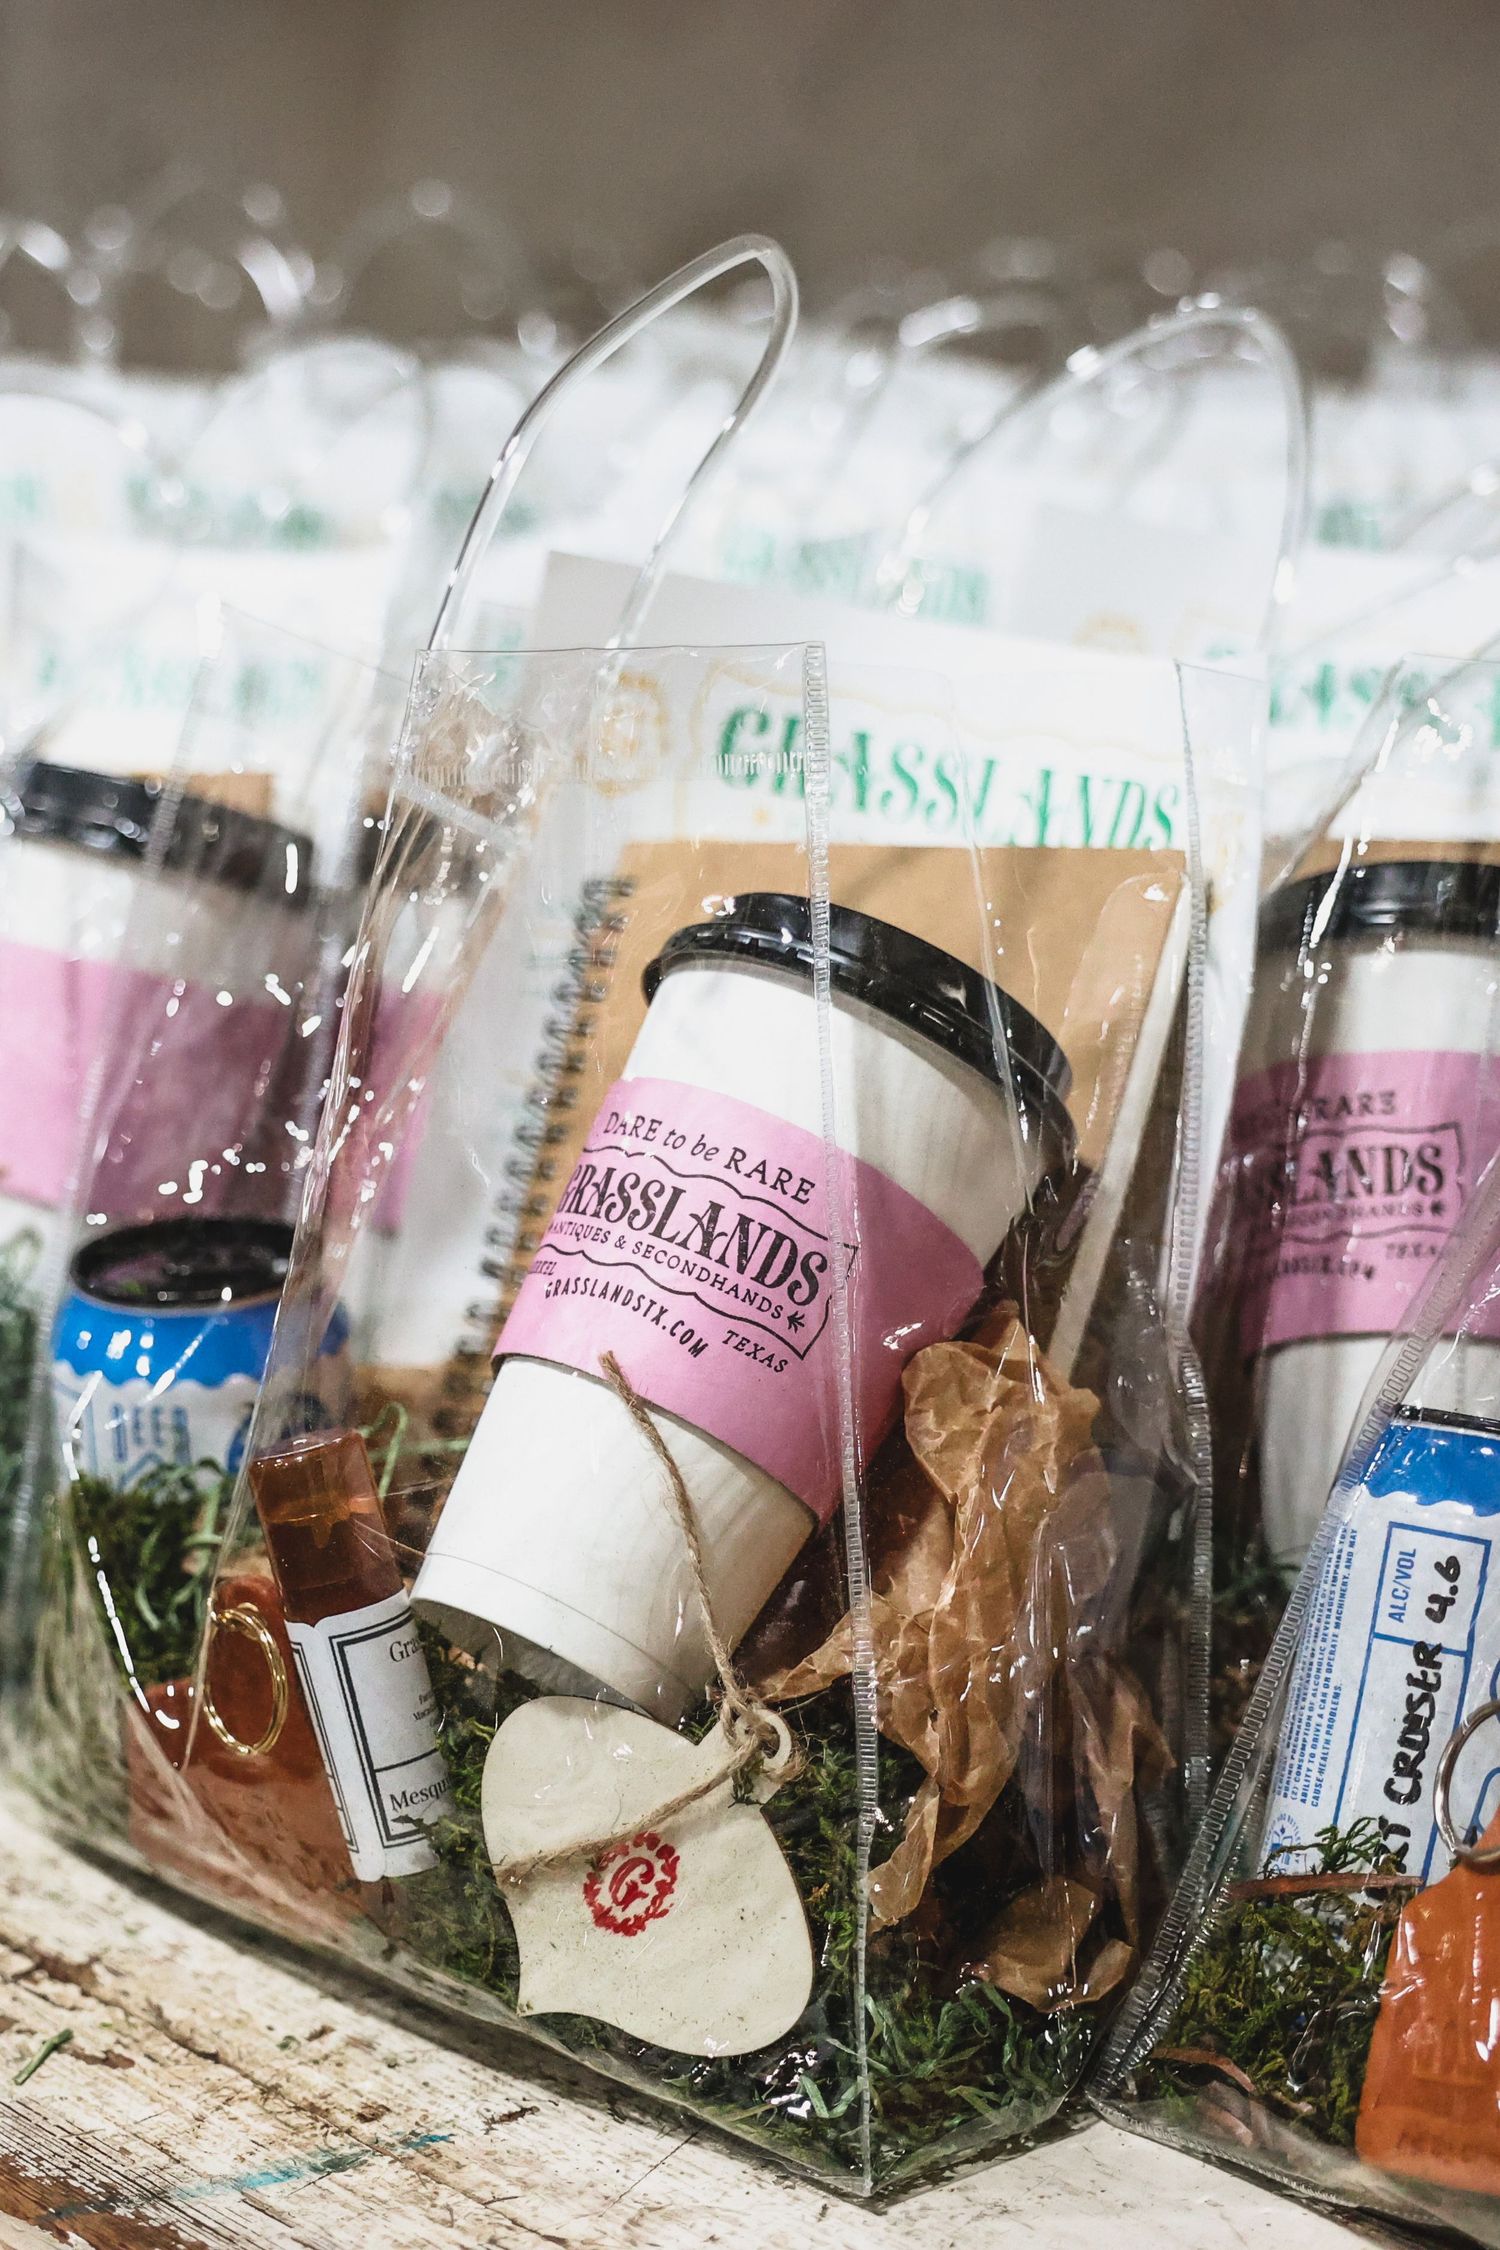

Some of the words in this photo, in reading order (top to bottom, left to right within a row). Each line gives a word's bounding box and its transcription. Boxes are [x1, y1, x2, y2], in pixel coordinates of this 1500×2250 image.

[604, 1112, 662, 1142] DARE
[663, 1129, 686, 1149] to
[691, 1134, 720, 1161] be
[723, 1147, 815, 1205] RARE
[556, 1164, 828, 1306] GRASSLANDS
[550, 1221, 611, 1244] ANTIQUES
[614, 1235, 627, 1249] &
[632, 1241, 784, 1319] SECONDHANDS
[545, 1277, 709, 1358] GRASSLANDSTX.COM
[722, 1329, 788, 1373] TEXAS
[1348, 1528, 1358, 1548] MAY
[1344, 1550, 1353, 1570] AND
[1388, 1548, 1416, 1623] ALC/VOL
[1425, 1555, 1460, 1624] 4.6
[389, 1638, 421, 1662] Gra
[1326, 1633, 1339, 1674] OPERATE
[1295, 1714, 1312, 1783] CONSUMPTION
[1311, 1645, 1325, 1698] ALCOHOLIC
[1321, 1589, 1336, 1643] BEVERAGES
[1319, 1691, 1328, 1711] CAR
[1323, 1676, 1331, 1689] OR
[1311, 1722, 1322, 1750] DRIVE
[1311, 1775, 1323, 1808] CAUSE
[1318, 1738, 1331, 1775] HEALTH
[1325, 1682, 1342, 1736] PROBLEMS.
[1308, 1752, 1316, 1764] TO
[389, 1778, 449, 1813] Mesqu
[1300, 1767, 1312, 1804] ABILITY
